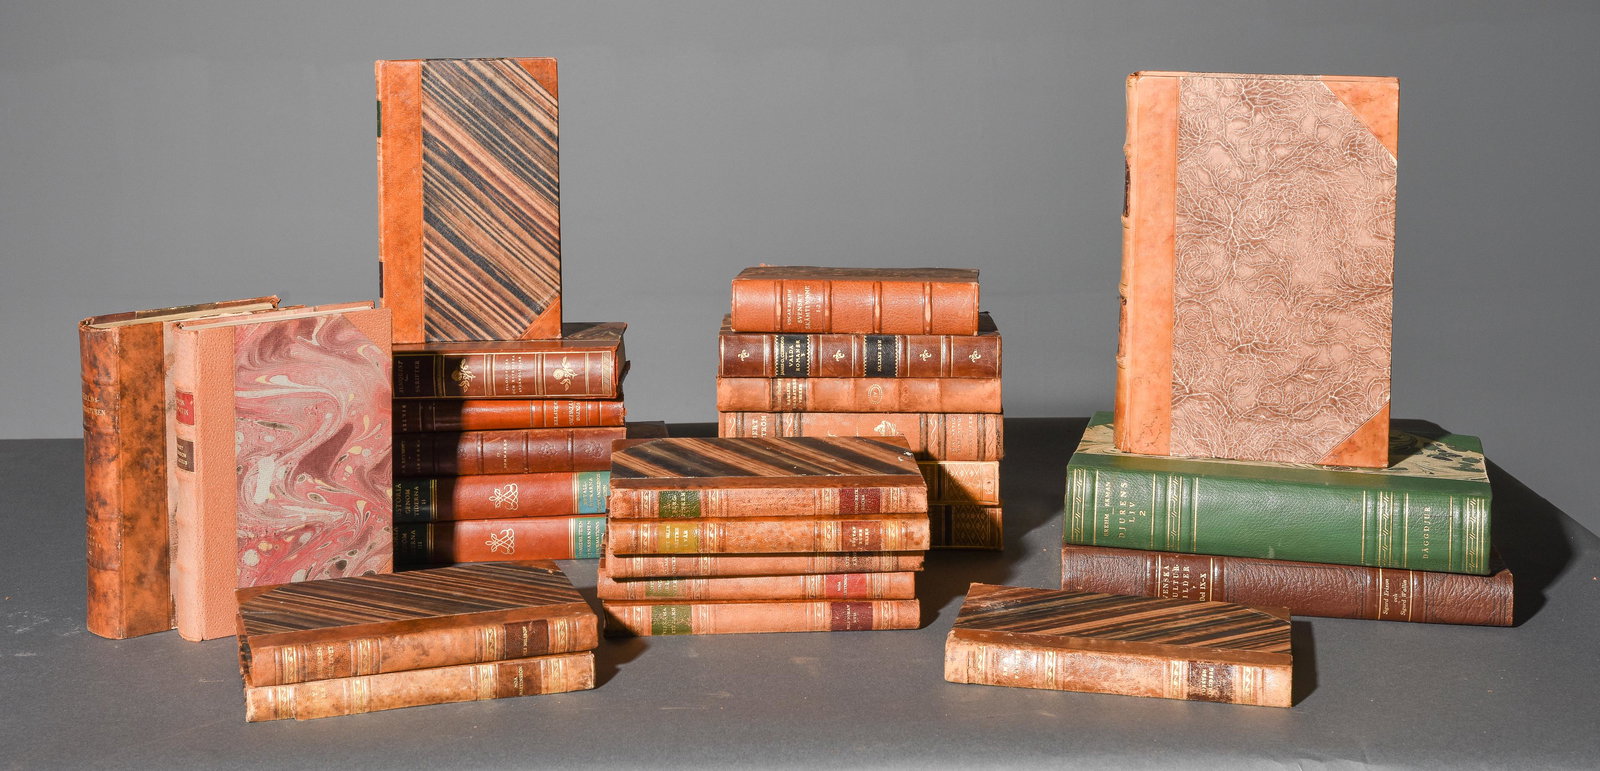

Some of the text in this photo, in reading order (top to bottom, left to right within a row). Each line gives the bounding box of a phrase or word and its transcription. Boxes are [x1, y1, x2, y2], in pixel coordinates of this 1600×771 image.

[1118, 481, 1128, 539] DJURENS
[1128, 501, 1136, 523] LIV
[1421, 506, 1431, 559] DÄGGDJUR
[1162, 565, 1170, 599] ENSKA
[1171, 564, 1180, 598] ULTUR-
[1182, 566, 1190, 599] ILDER
